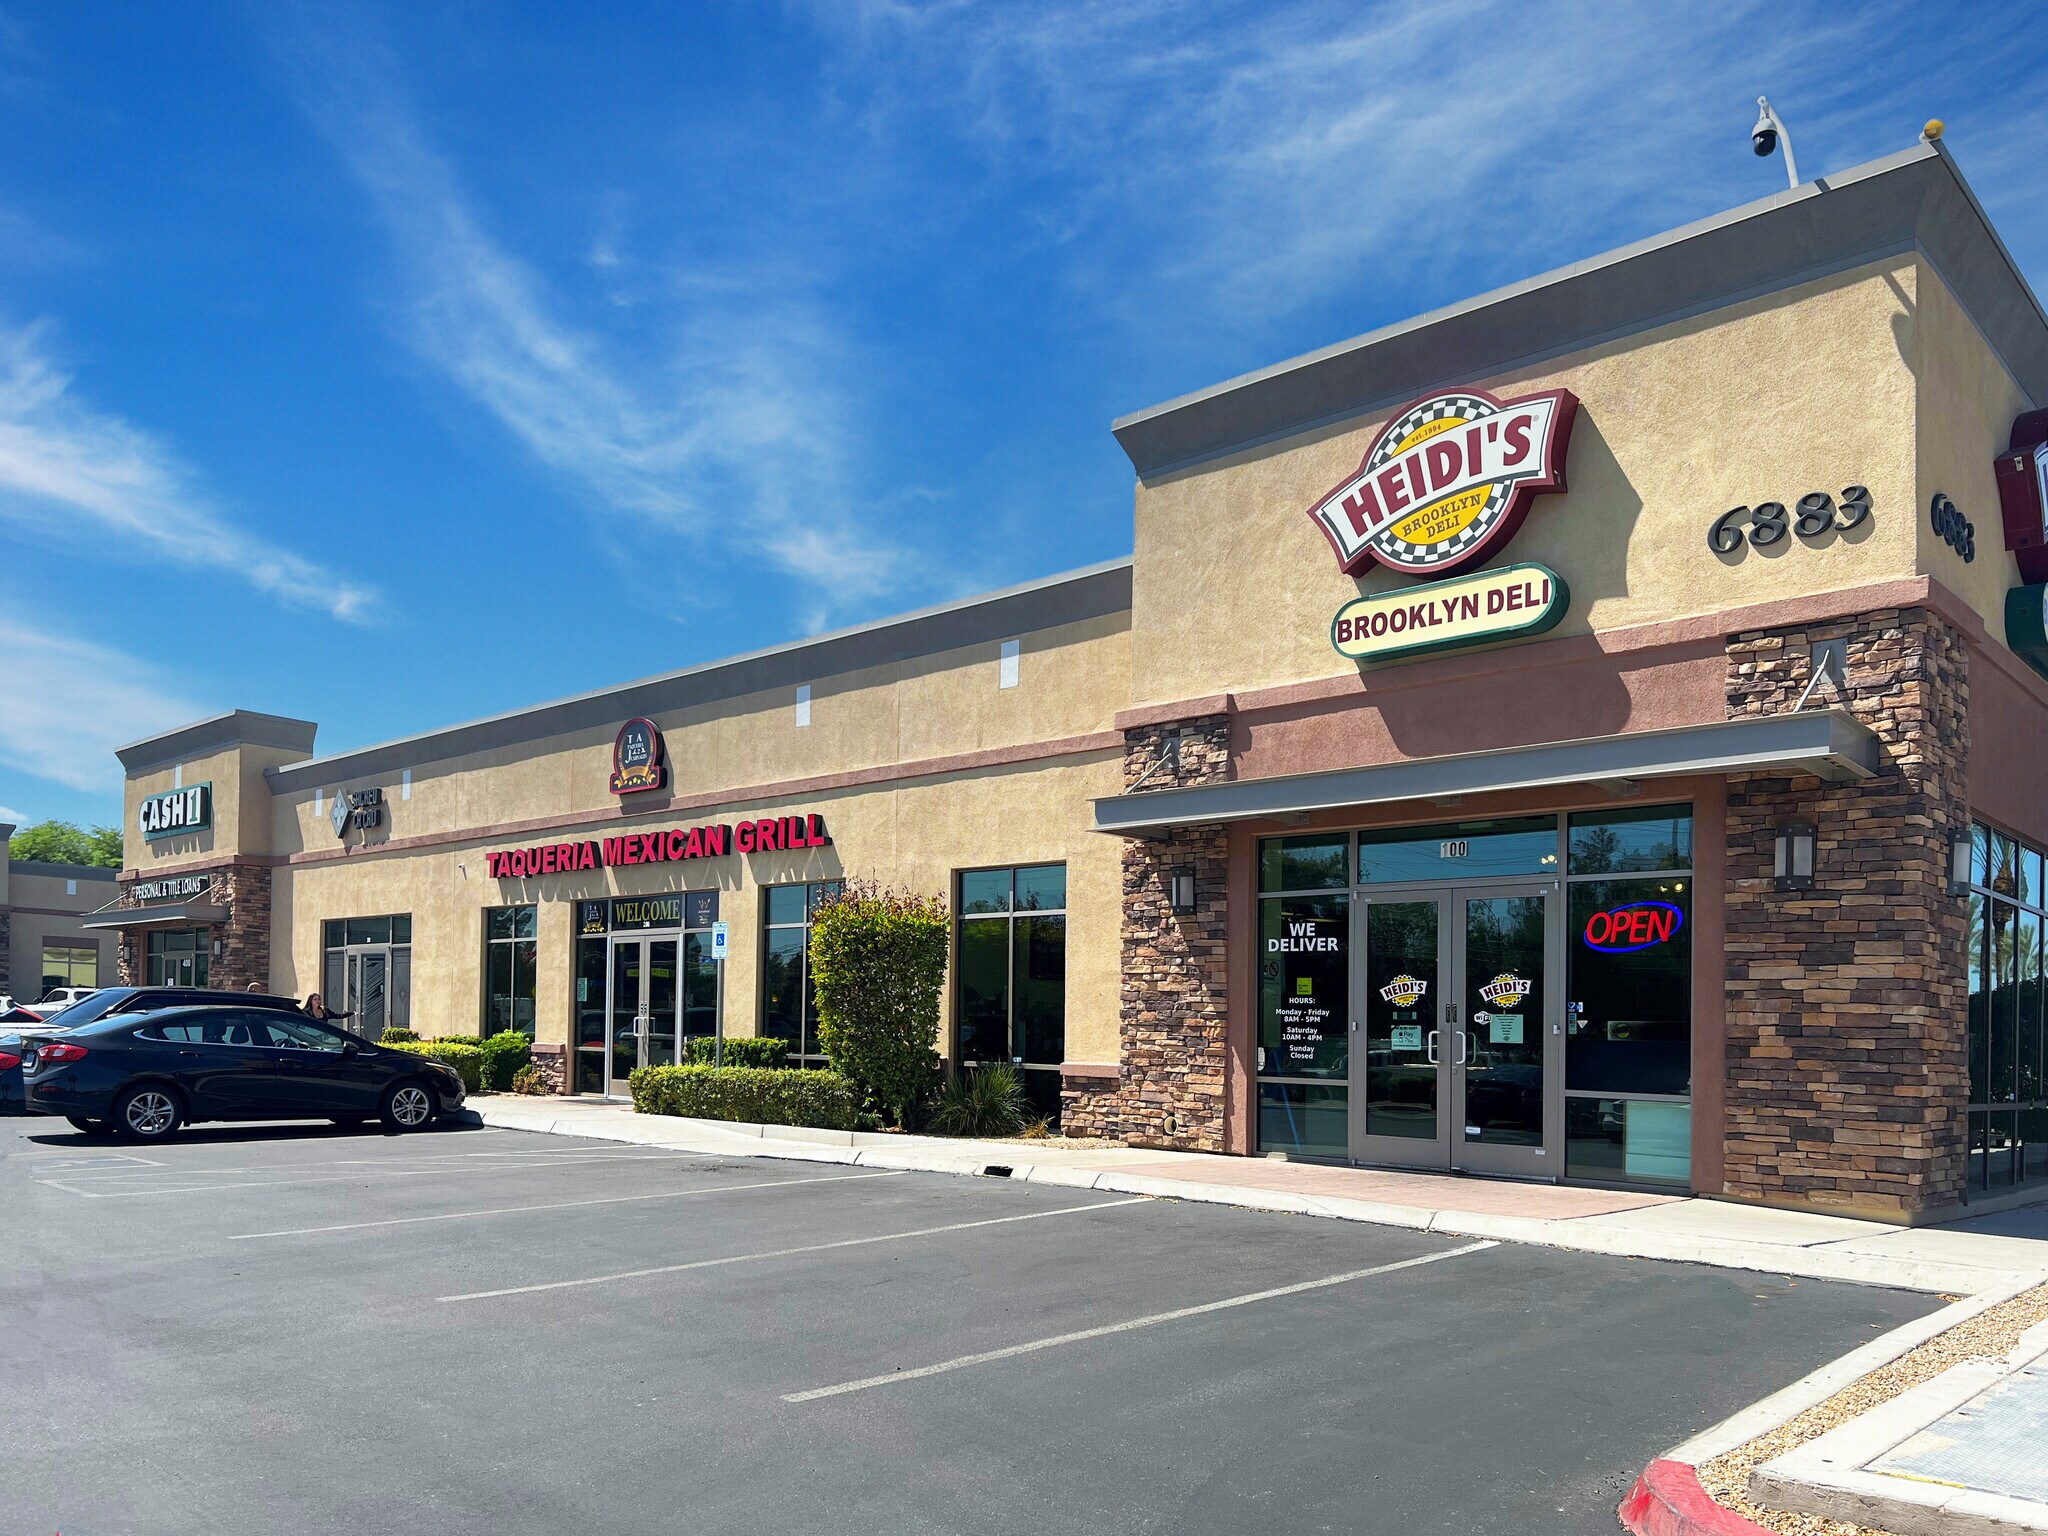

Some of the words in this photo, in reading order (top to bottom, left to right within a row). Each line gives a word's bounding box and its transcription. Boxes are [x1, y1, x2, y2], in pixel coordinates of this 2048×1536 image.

[1341, 414, 1533, 538] HEIDI'S
[1402, 493, 1481, 538] BROOKLYN
[1707, 485, 1869, 553] 6883
[1426, 514, 1461, 538] DELI
[1337, 592, 1479, 643] BROOKLYN
[1487, 578, 1549, 615] DELI
[485, 841, 597, 878] TAQUERIA
[603, 824, 726, 867] MEXICAN
[735, 814, 828, 854] GRILL
[1442, 841, 1466, 857] 100
[135, 882, 162, 899] PERSONAL
[168, 880, 181, 895] TITLE
[181, 877, 201, 894] LOANS
[615, 900, 680, 923] WELCOME
[1289, 923, 1316, 937] WE
[1586, 911, 1673, 944] OPEN
[1268, 937, 1339, 952] DELIVER
[1384, 982, 1424, 999] HEIDI'S
[1483, 981, 1528, 999] HEIDI'S
[1275, 1008, 1302, 1016] Monday
[1308, 1008, 1330, 1017] Friday
[1286, 1027, 1318, 1035] Saturday
[1404, 1031, 1414, 1039] Pay
[1289, 1045, 1315, 1053] Sunday
